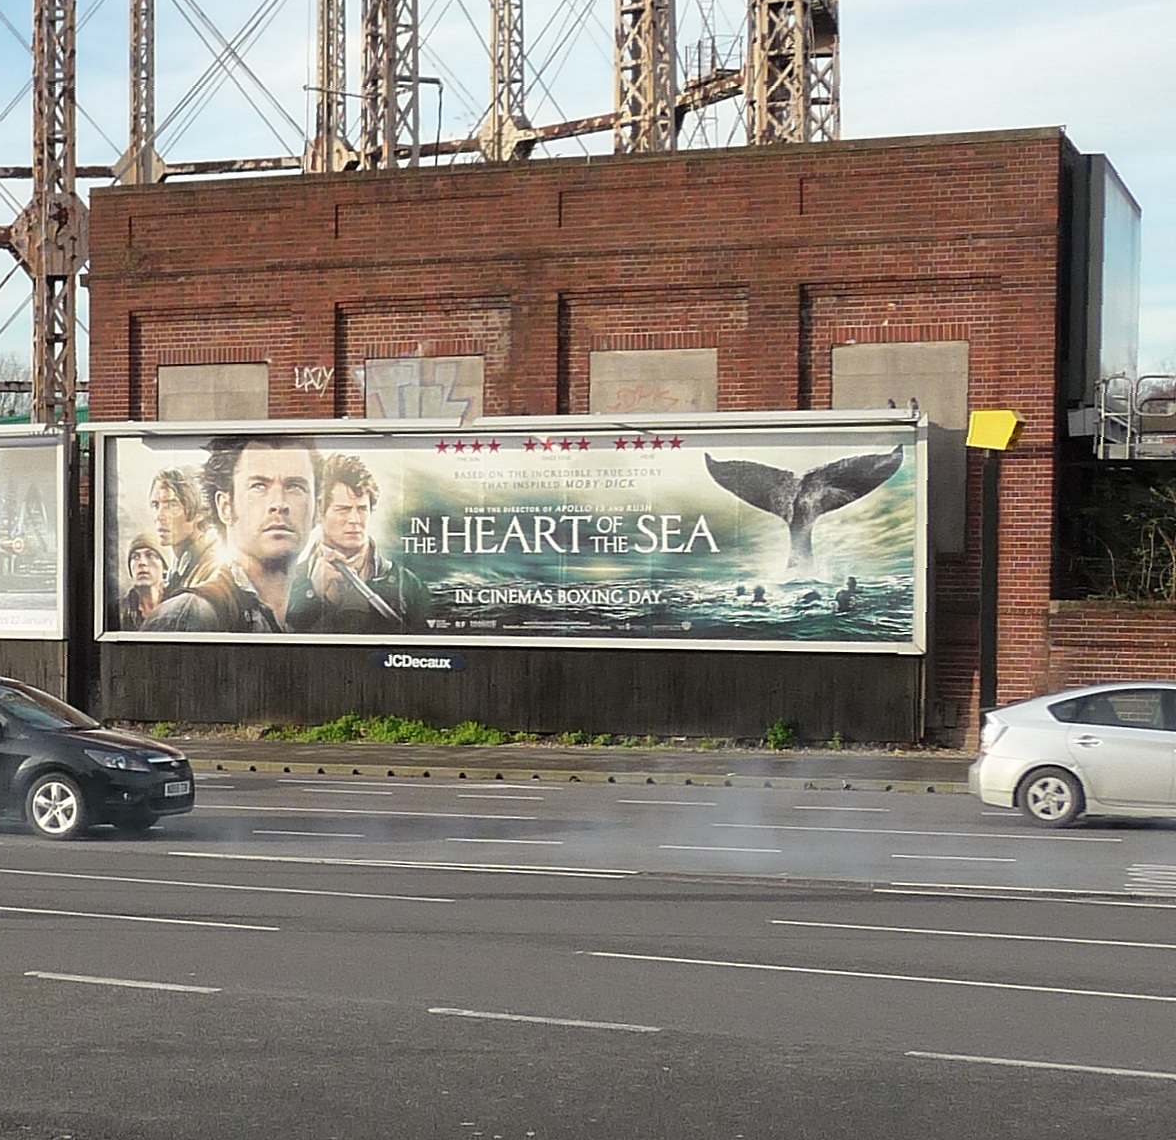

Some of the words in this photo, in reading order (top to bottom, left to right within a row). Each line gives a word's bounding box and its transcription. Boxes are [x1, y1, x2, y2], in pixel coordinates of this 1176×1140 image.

[454, 470, 485, 479] BASED
[489, 470, 503, 479] ON
[508, 469, 528, 478] THE
[532, 468, 592, 478] INCREDIBLE
[596, 468, 624, 477] TRUE
[627, 467, 662, 477] STORY
[482, 481, 508, 490] THAT
[513, 480, 560, 489] INSPIRED
[503, 505, 541, 513] DIRECTOR
[555, 504, 593, 512] APOLLO
[595, 504, 606, 512] 13
[626, 504, 652, 512] RUSH
[410, 517, 430, 533] IN
[596, 516, 623, 533] OF
[441, 515, 593, 554] HEART
[634, 514, 720, 553] SEA
[401, 536, 437, 554] THE
[590, 536, 629, 553] THE
[455, 590, 474, 604] IN
[477, 589, 552, 604] CINEMAS
[558, 589, 623, 604] BOXING
[628, 590, 662, 604] DAY
[384, 654, 451, 668] JCDecaux
